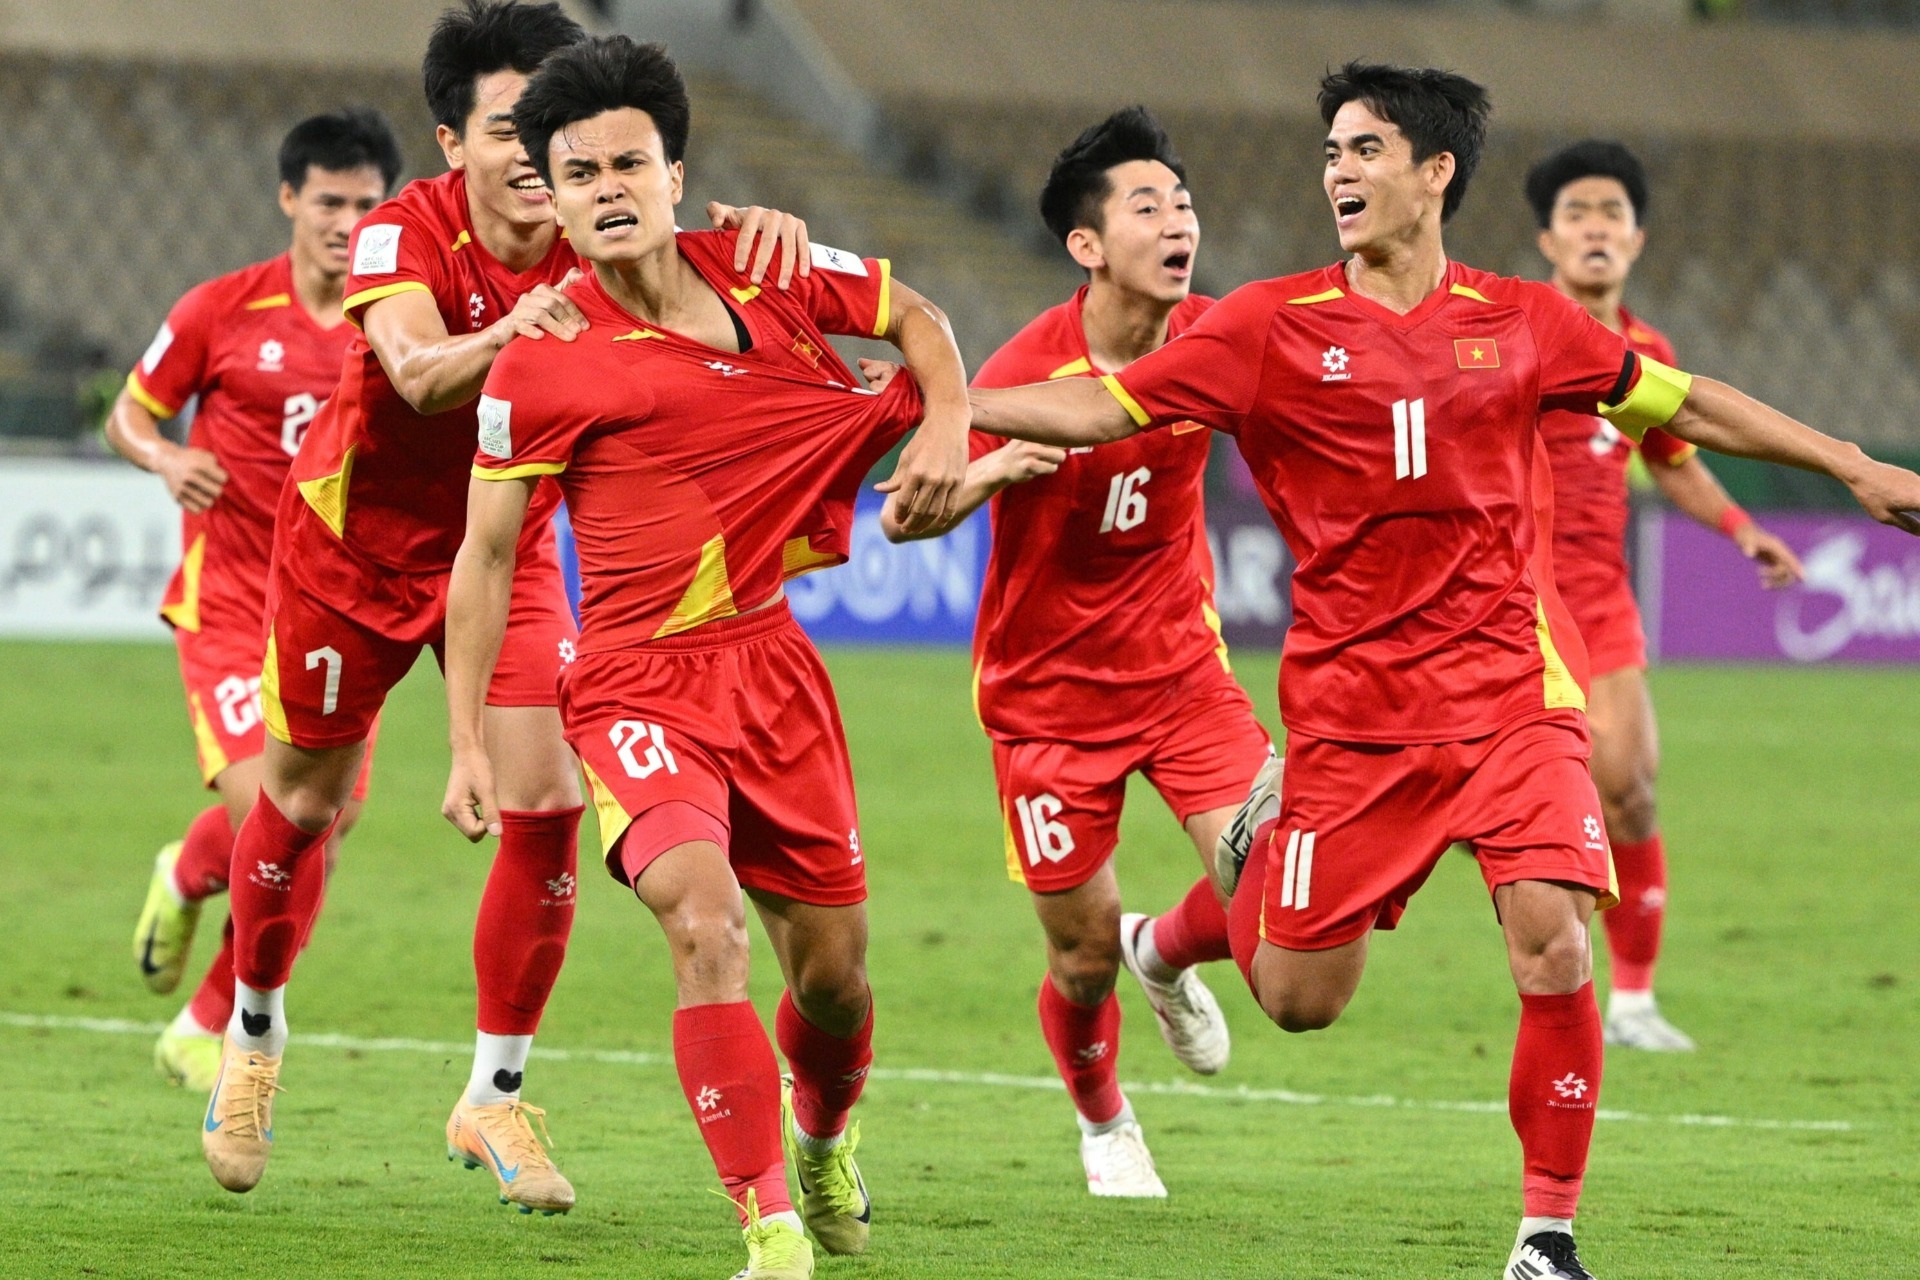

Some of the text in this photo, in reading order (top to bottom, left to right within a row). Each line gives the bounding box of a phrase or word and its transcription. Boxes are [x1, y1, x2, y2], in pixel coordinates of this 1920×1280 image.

[281, 391, 330, 457] 2
[1391, 397, 1428, 480] 11
[1099, 465, 1152, 534] 16
[214, 674, 264, 737] 2
[305, 645, 343, 716] 7
[608, 719, 680, 780] 21
[1014, 792, 1076, 867] 16
[1280, 828, 1317, 911] 11
